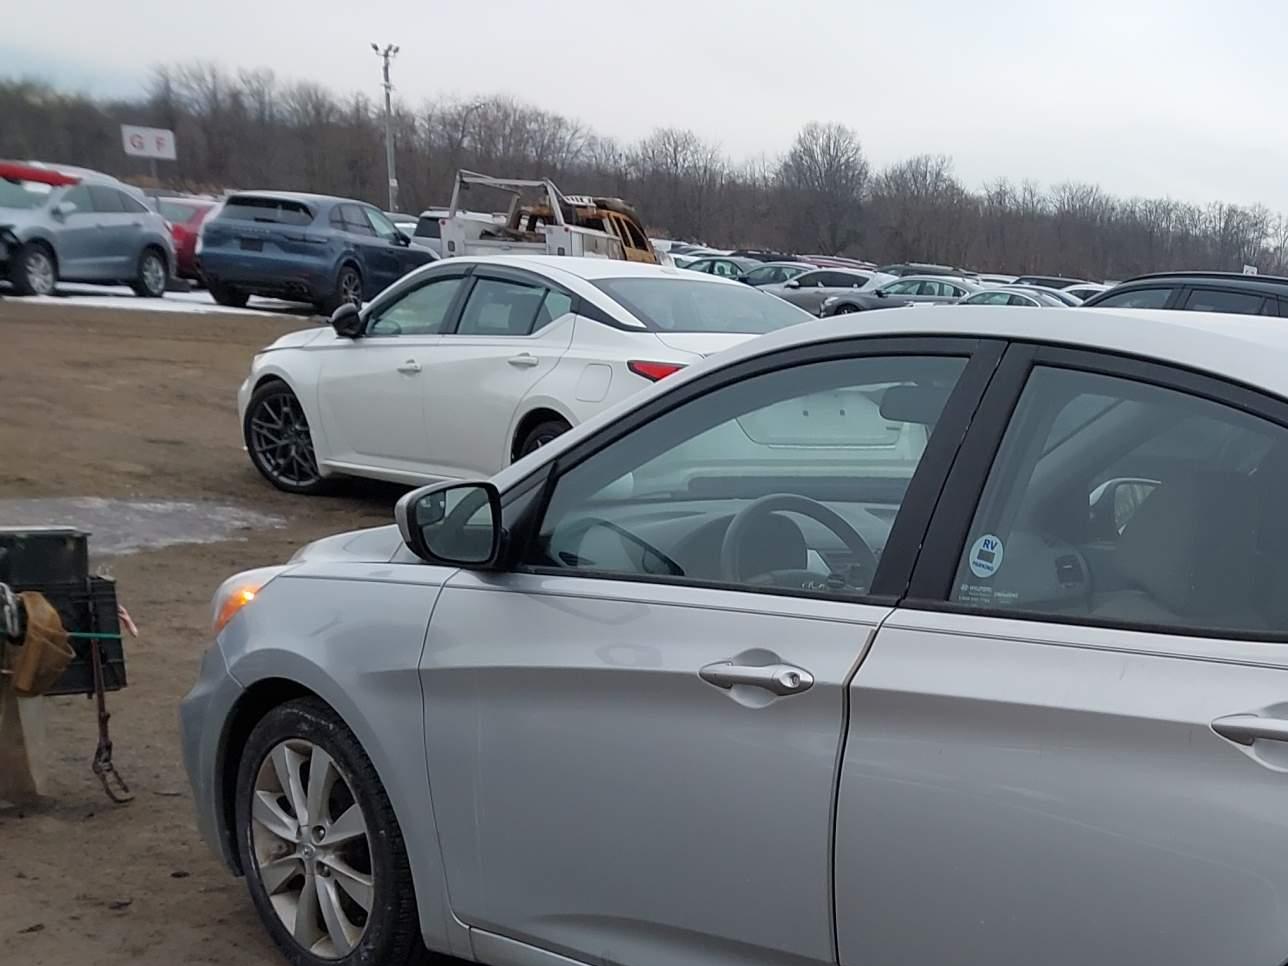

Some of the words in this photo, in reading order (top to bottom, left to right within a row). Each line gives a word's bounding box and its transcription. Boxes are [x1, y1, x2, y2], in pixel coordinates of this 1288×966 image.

[130, 134, 144, 150] G
[155, 136, 166, 152] F
[983, 539, 998, 551] RV
